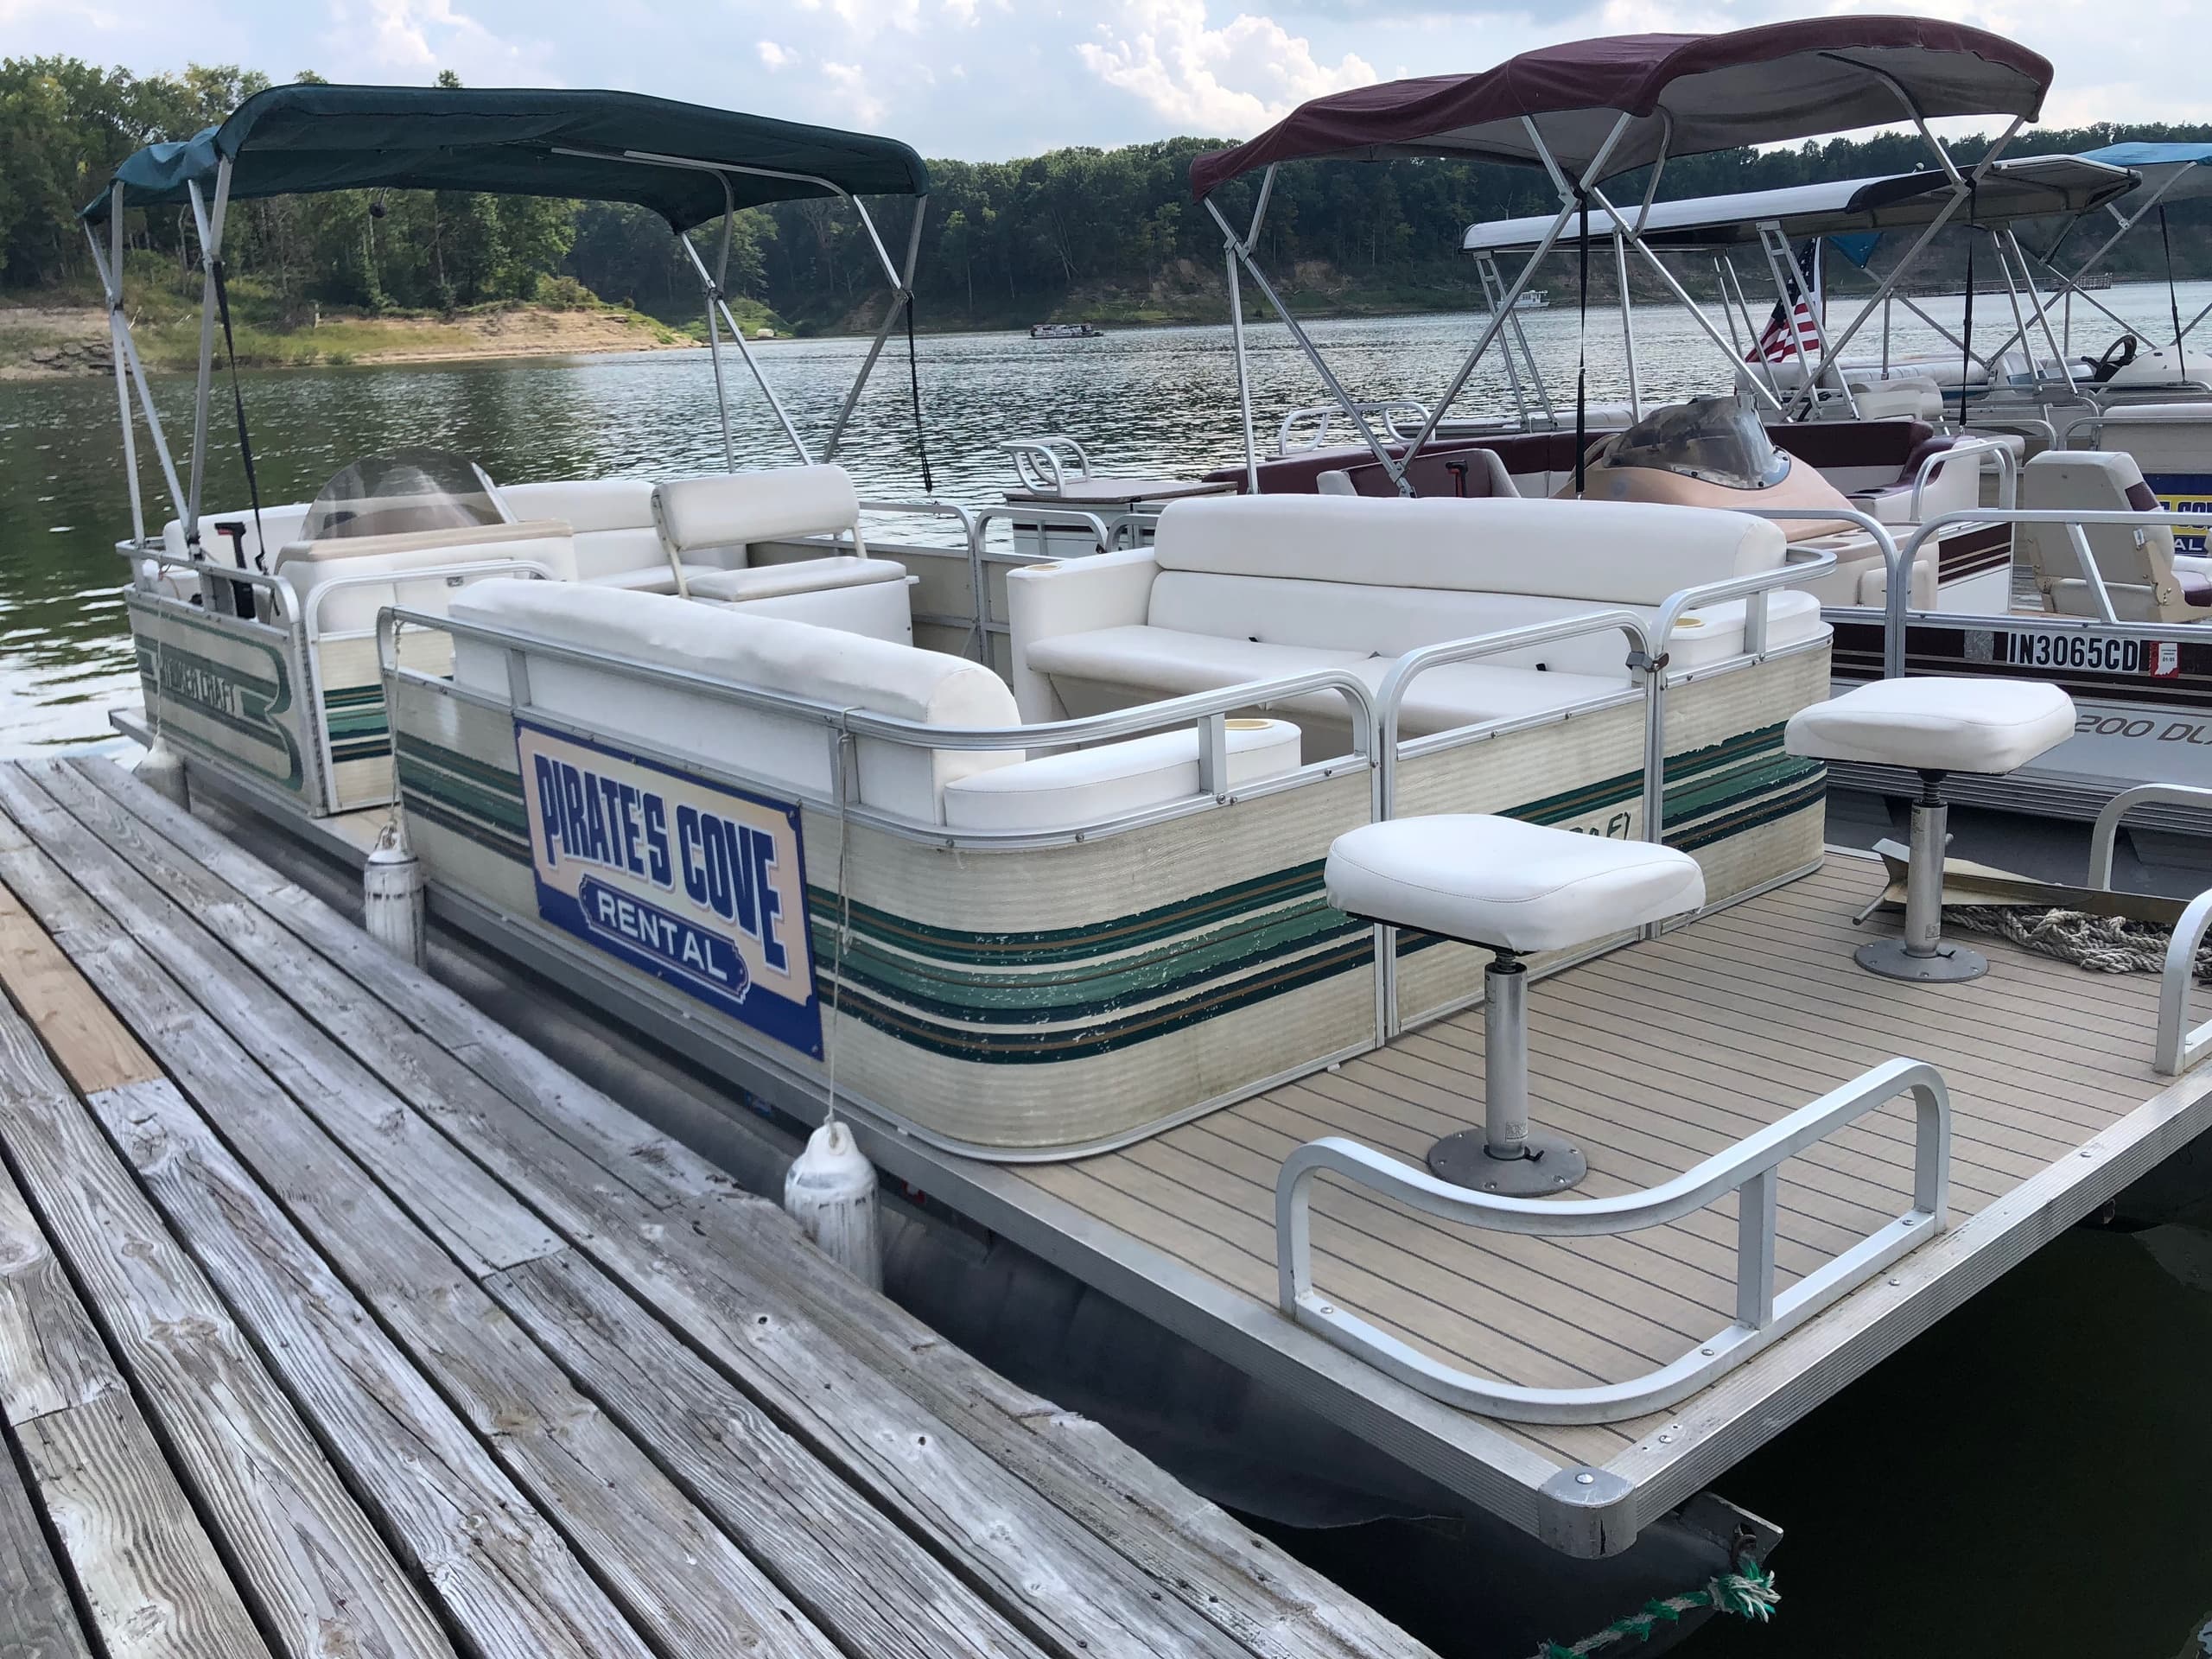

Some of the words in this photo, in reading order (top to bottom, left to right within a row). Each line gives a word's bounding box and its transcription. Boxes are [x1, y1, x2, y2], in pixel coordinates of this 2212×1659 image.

[2010, 633, 2139, 671] IN3065CD
[2074, 715, 2154, 738] 200
[2157, 722, 2211, 746] DL
[534, 753, 671, 887] PIRATE'S
[677, 805, 787, 973] COVE
[598, 891, 728, 979] RENTAL
